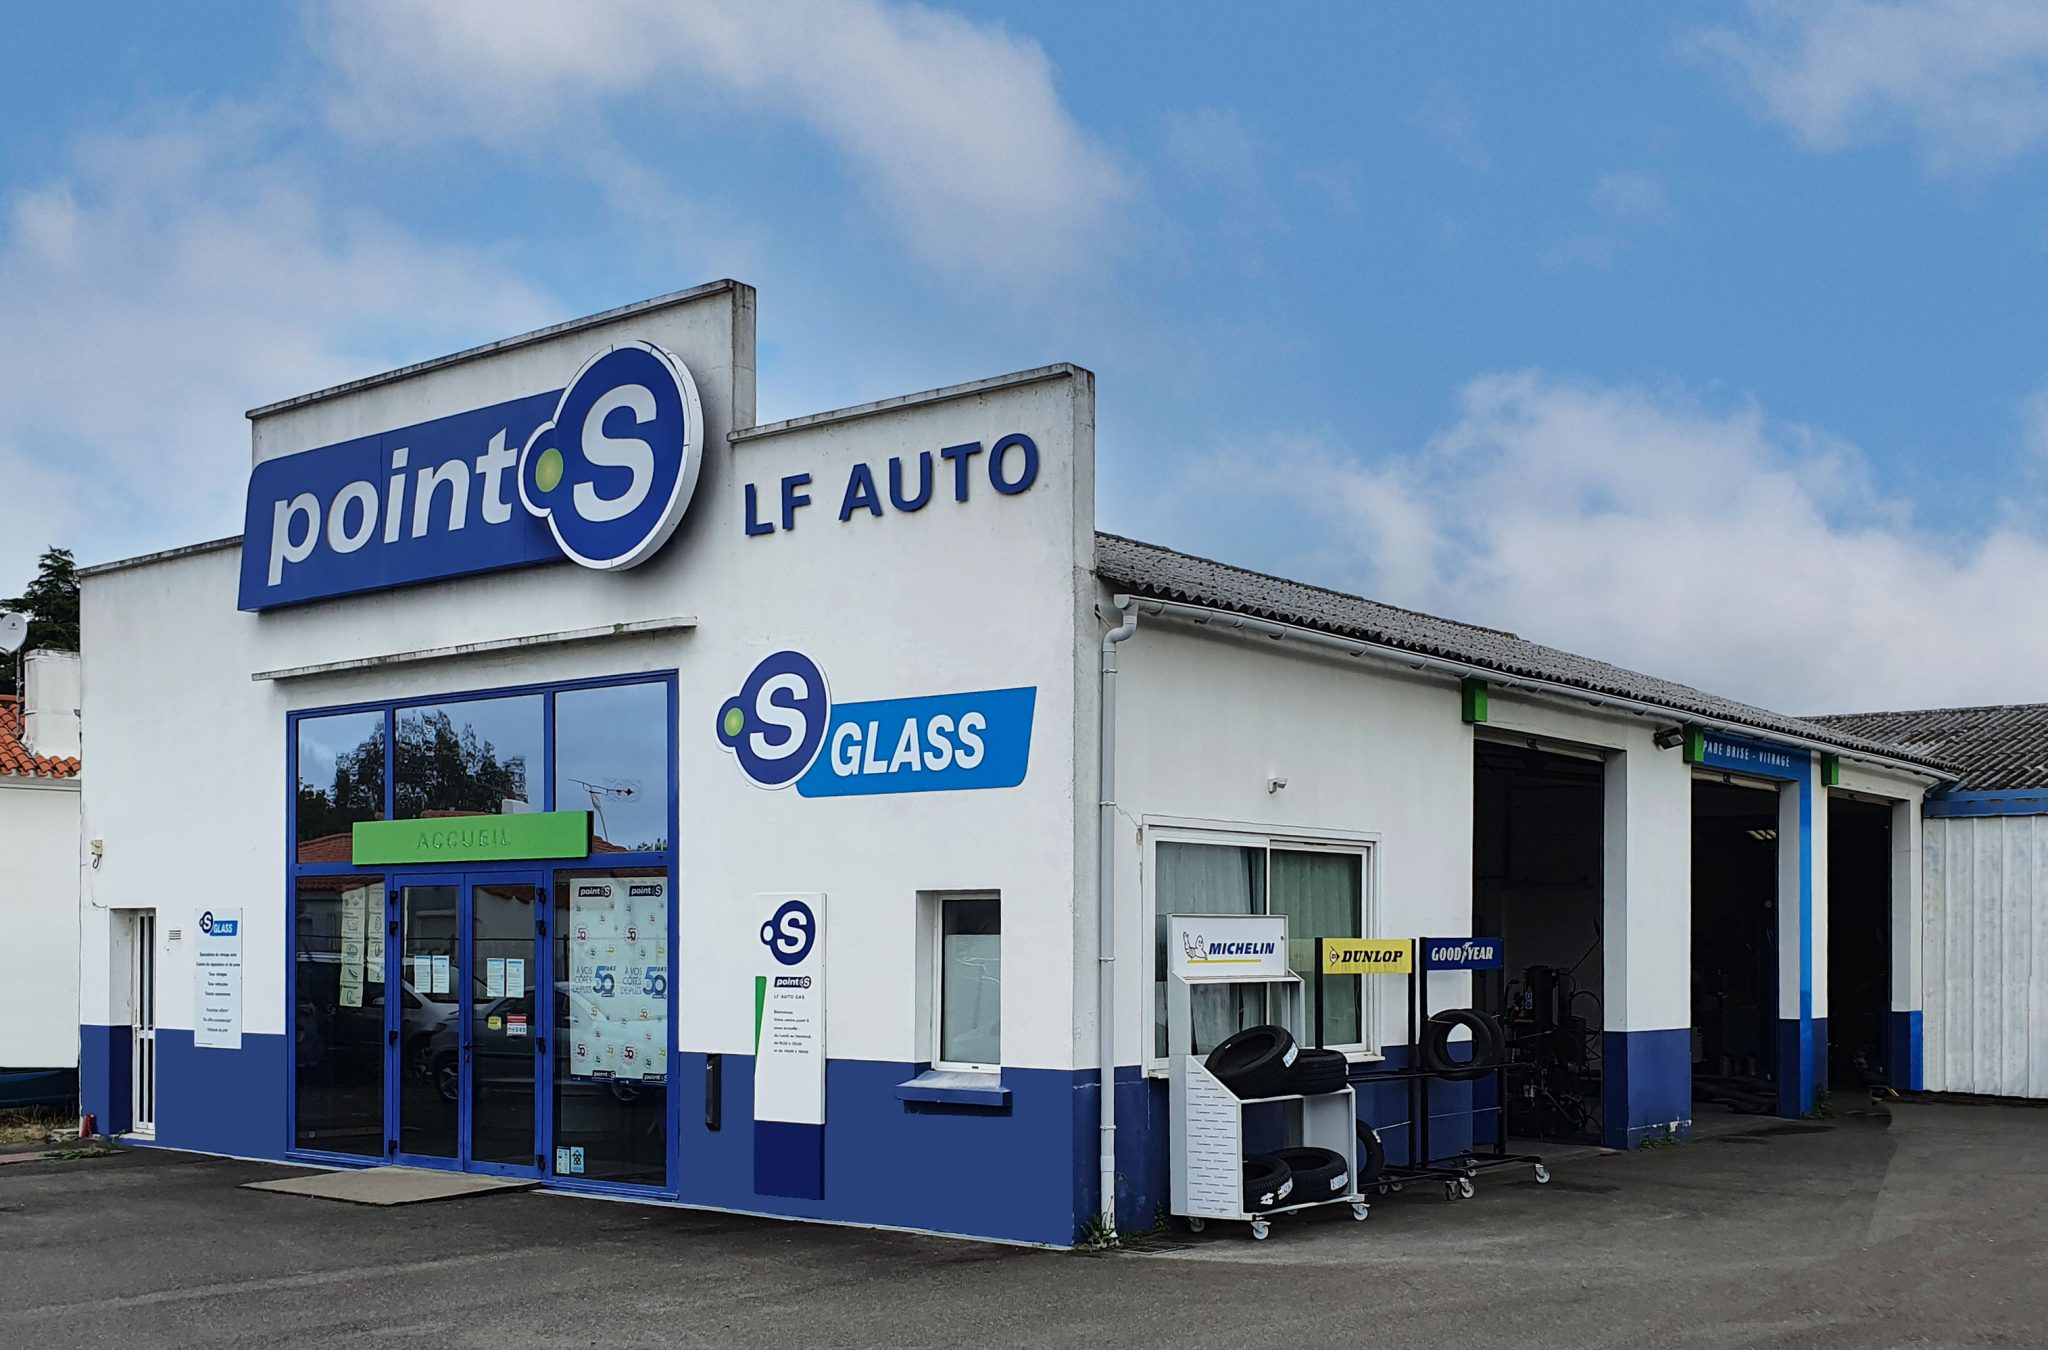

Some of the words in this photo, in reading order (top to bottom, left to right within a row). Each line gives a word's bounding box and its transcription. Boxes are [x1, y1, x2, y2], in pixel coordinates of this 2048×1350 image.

[267, 427, 518, 587] point
[572, 383, 657, 522] S
[744, 473, 812, 536] LF
[838, 432, 1040, 521] AUTO
[749, 672, 809, 760] S
[830, 711, 987, 777] GLASS
[1703, 740, 1723, 756] PARE
[1726, 746, 1749, 760] BRISE
[1759, 752, 1790, 767] VITRAGE
[416, 828, 512, 849] ACCUEIL
[580, 887, 600, 896] point
[631, 887, 651, 896] point
[202, 914, 212, 930] S
[213, 923, 233, 933] GLASS
[777, 911, 807, 954] S
[1208, 942, 1275, 955] MICHELIN
[1341, 950, 1403, 963] DUNLOP
[1431, 945, 1494, 962] GOODYEAR
[593, 965, 615, 993] 50
[643, 966, 667, 996] 50
[776, 978, 798, 986] point
